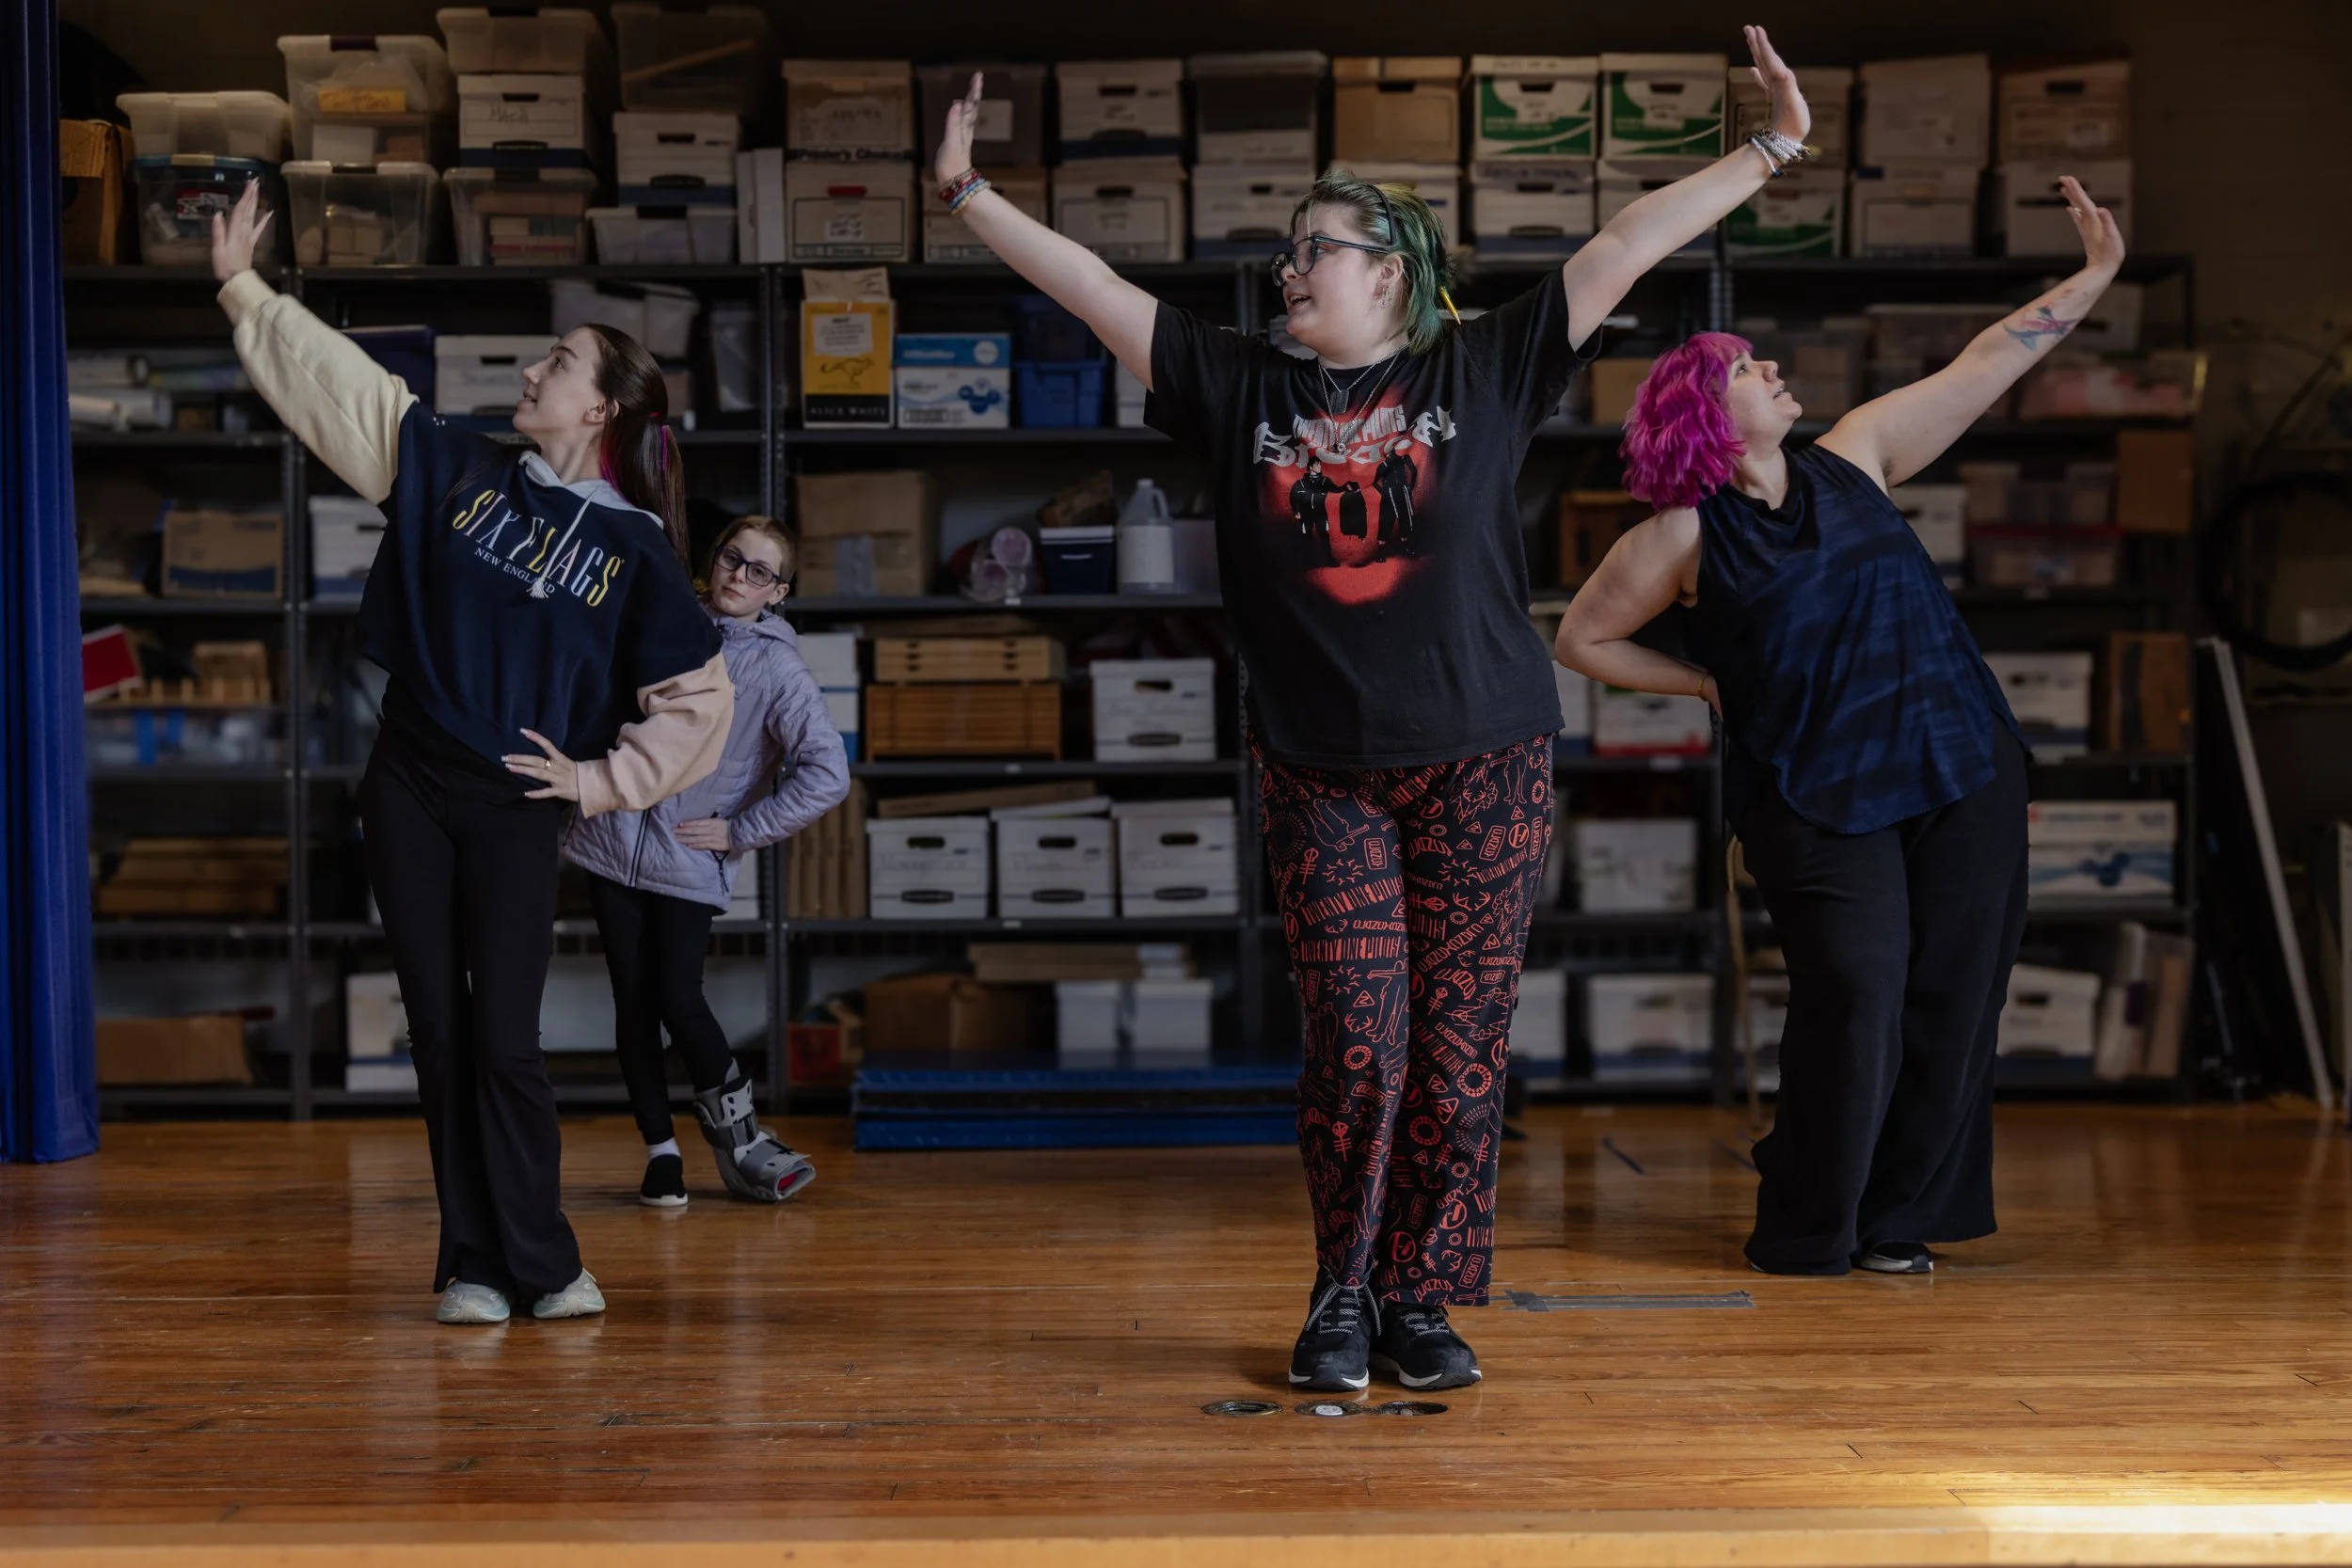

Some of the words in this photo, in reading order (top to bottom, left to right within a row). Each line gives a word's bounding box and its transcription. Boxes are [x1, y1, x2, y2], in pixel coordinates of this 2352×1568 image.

[452, 488, 522, 552] SIX
[505, 515, 622, 608] FLAGS
[474, 547, 502, 567] NEW
[503, 562, 556, 594] ENGLD
